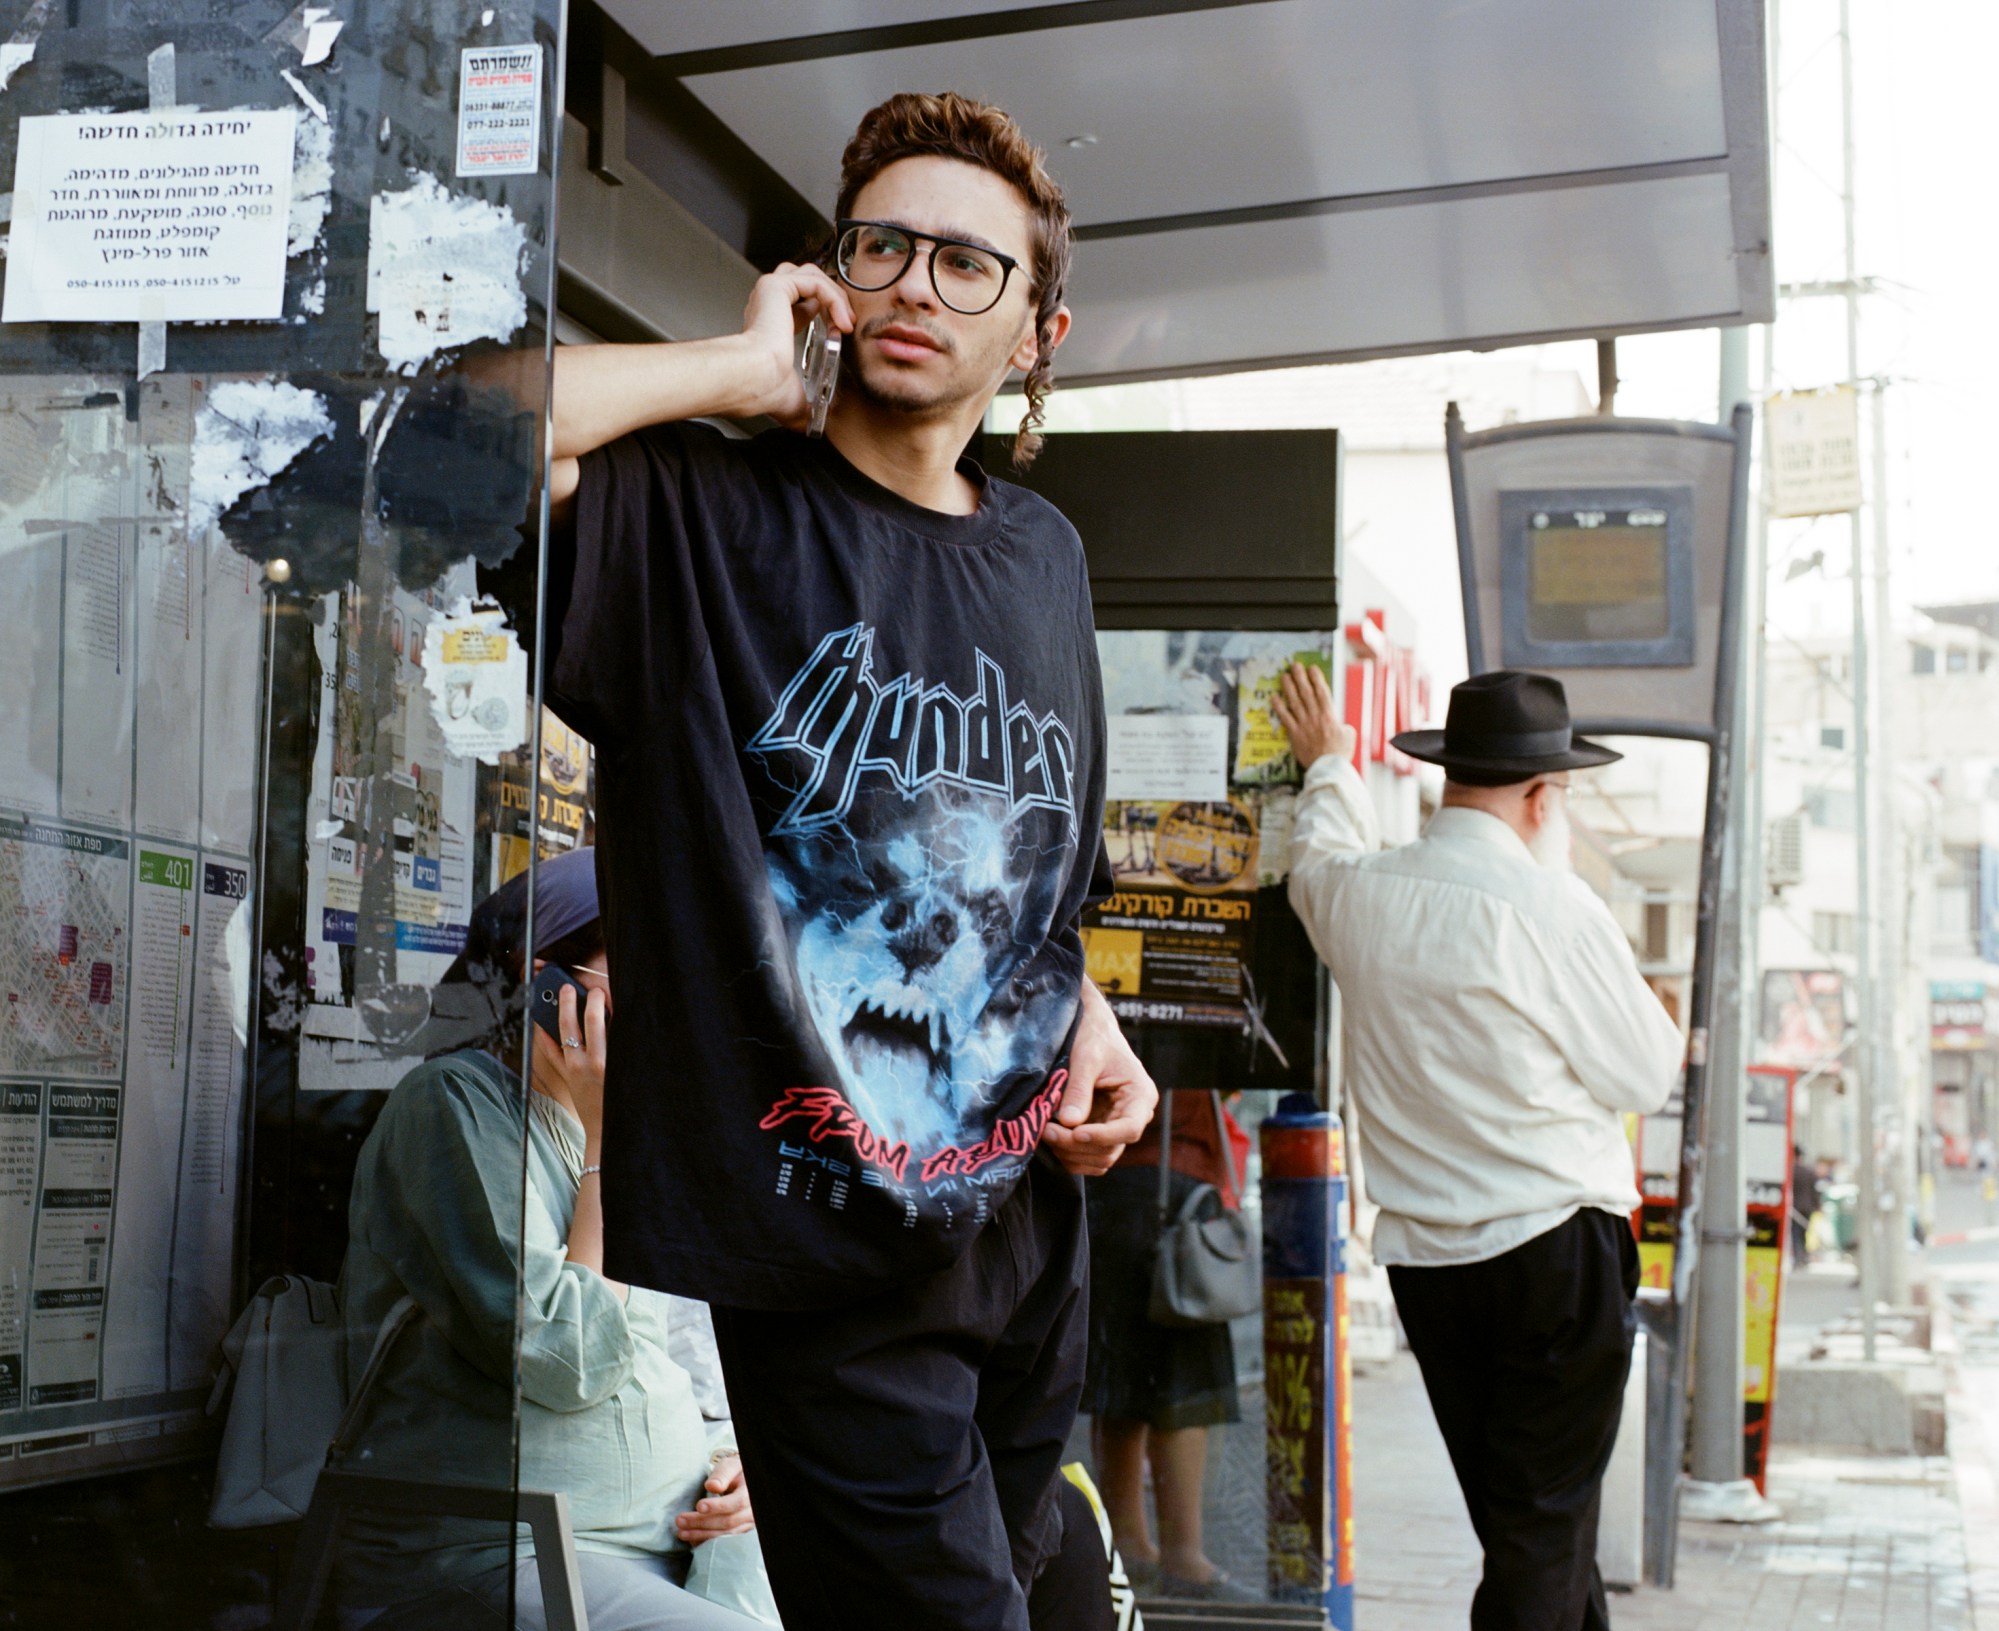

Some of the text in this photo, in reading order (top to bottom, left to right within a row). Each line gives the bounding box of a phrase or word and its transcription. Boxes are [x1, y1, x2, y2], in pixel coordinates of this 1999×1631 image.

[79, 121, 251, 140] יחידה גדולה חדשה!
[63, 164, 260, 182] חדשה מהנילונים, מדהימה,
[49, 183, 274, 201] גדולה, מרווחת ומאווררת, חדר
[47, 203, 273, 222] נוסף, סוכה, מושקעת, מרוהטת
[93, 225, 221, 241] קומפלט, ממוזגת
[101, 246, 210, 263] אזור פרל-מינץ
[35, 828, 63, 845] התחנה
[165, 859, 190, 887] 401
[417, 864, 435, 883] גברים
[224, 870, 246, 898] 350
[1180, 898, 1252, 921] השכרת
[8, 1092, 37, 1107] הודעות
[52, 1092, 117, 1112] מדריך למשתמש
[759, 1087, 911, 1182] FROM
